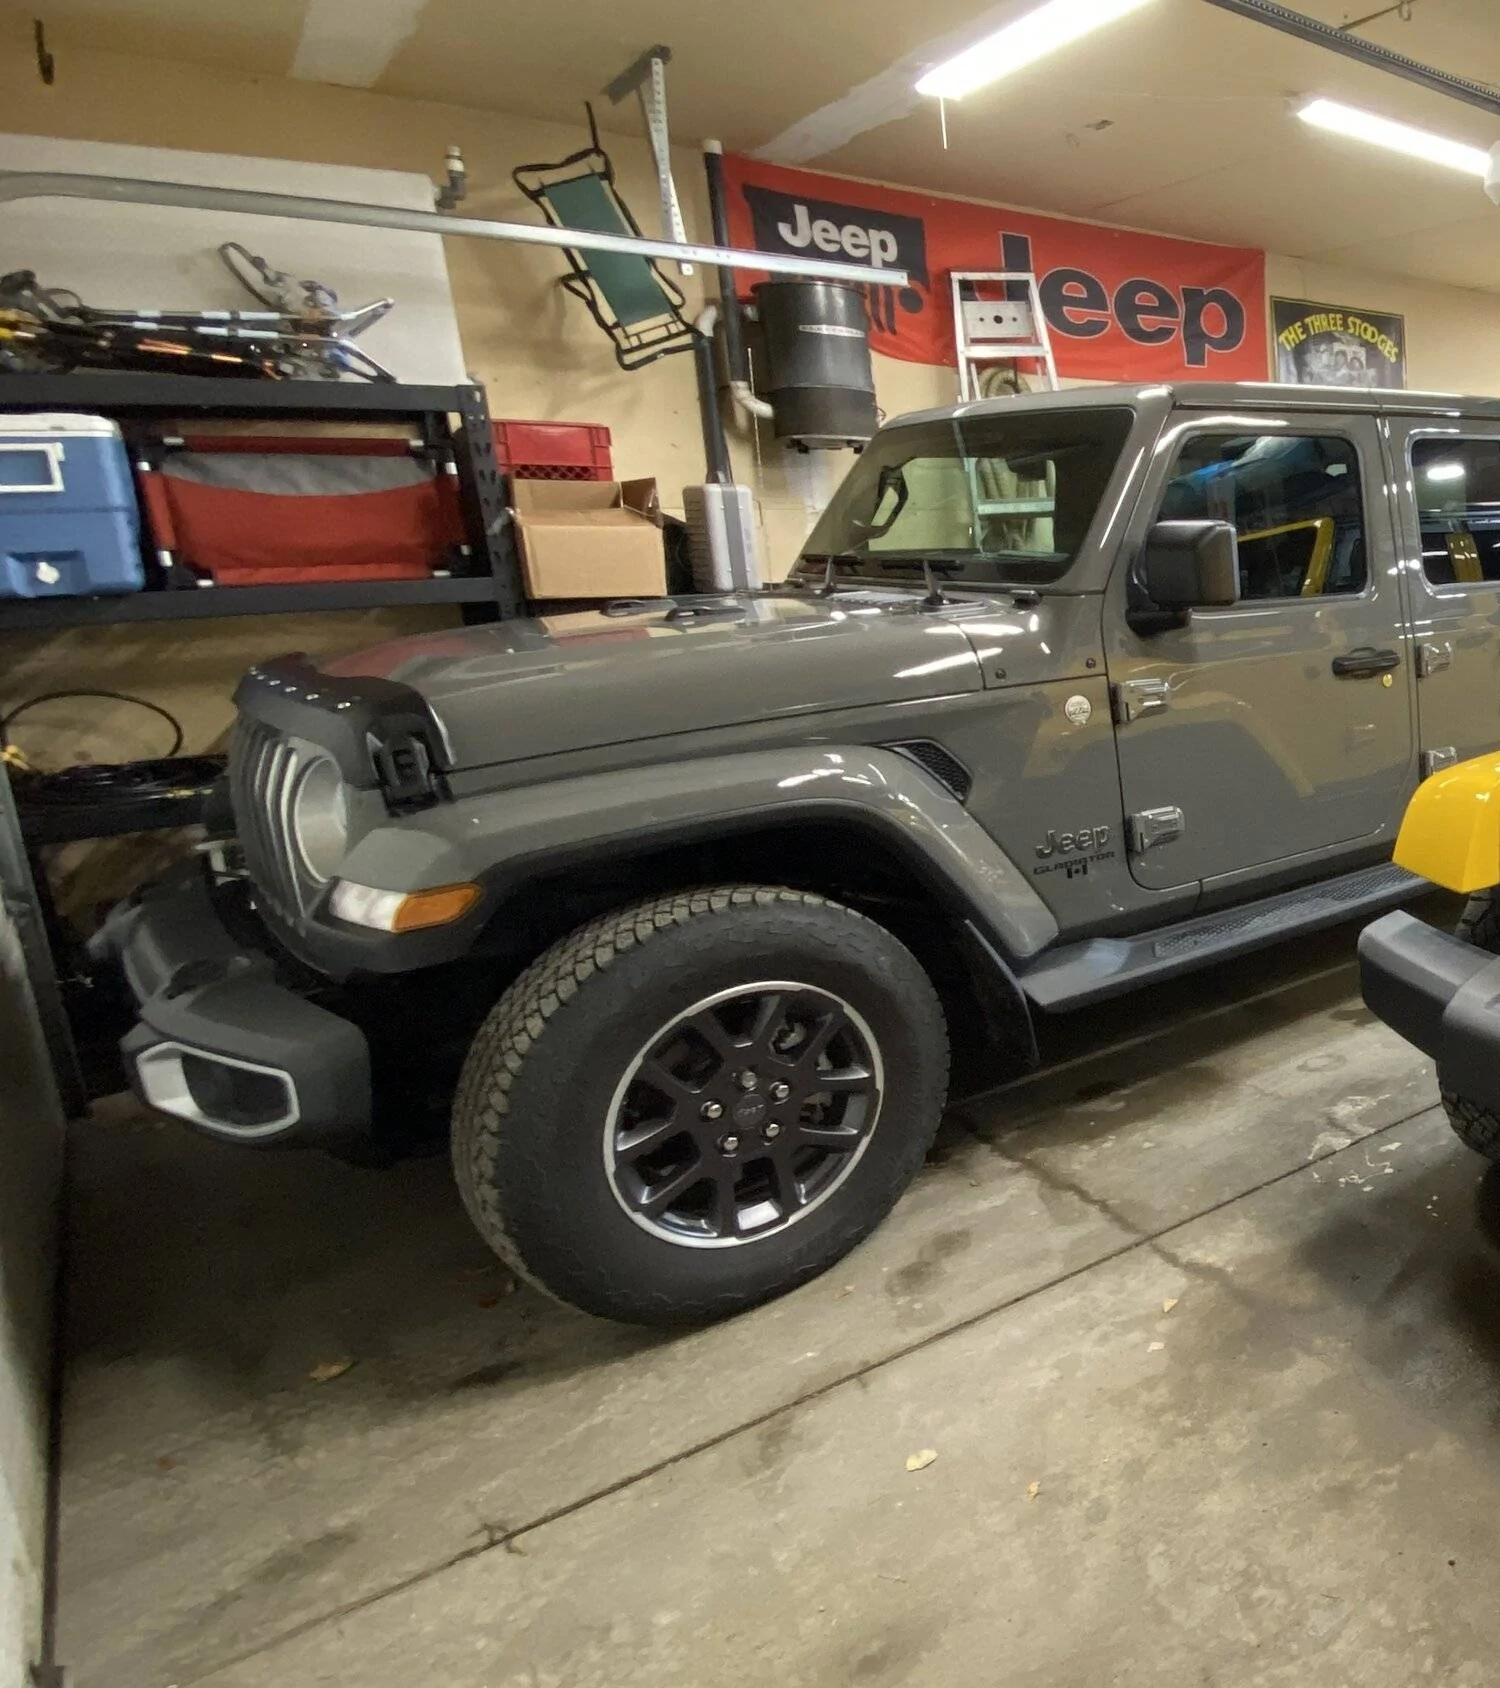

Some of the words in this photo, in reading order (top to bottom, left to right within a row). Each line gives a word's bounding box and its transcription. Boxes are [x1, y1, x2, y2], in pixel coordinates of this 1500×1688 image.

[776, 203, 898, 269] Jeep
[1278, 321, 1307, 352] THE
[1303, 313, 1344, 336] THREE
[1346, 316, 1400, 364] STOOGES
[1035, 825, 1111, 859] Jeep
